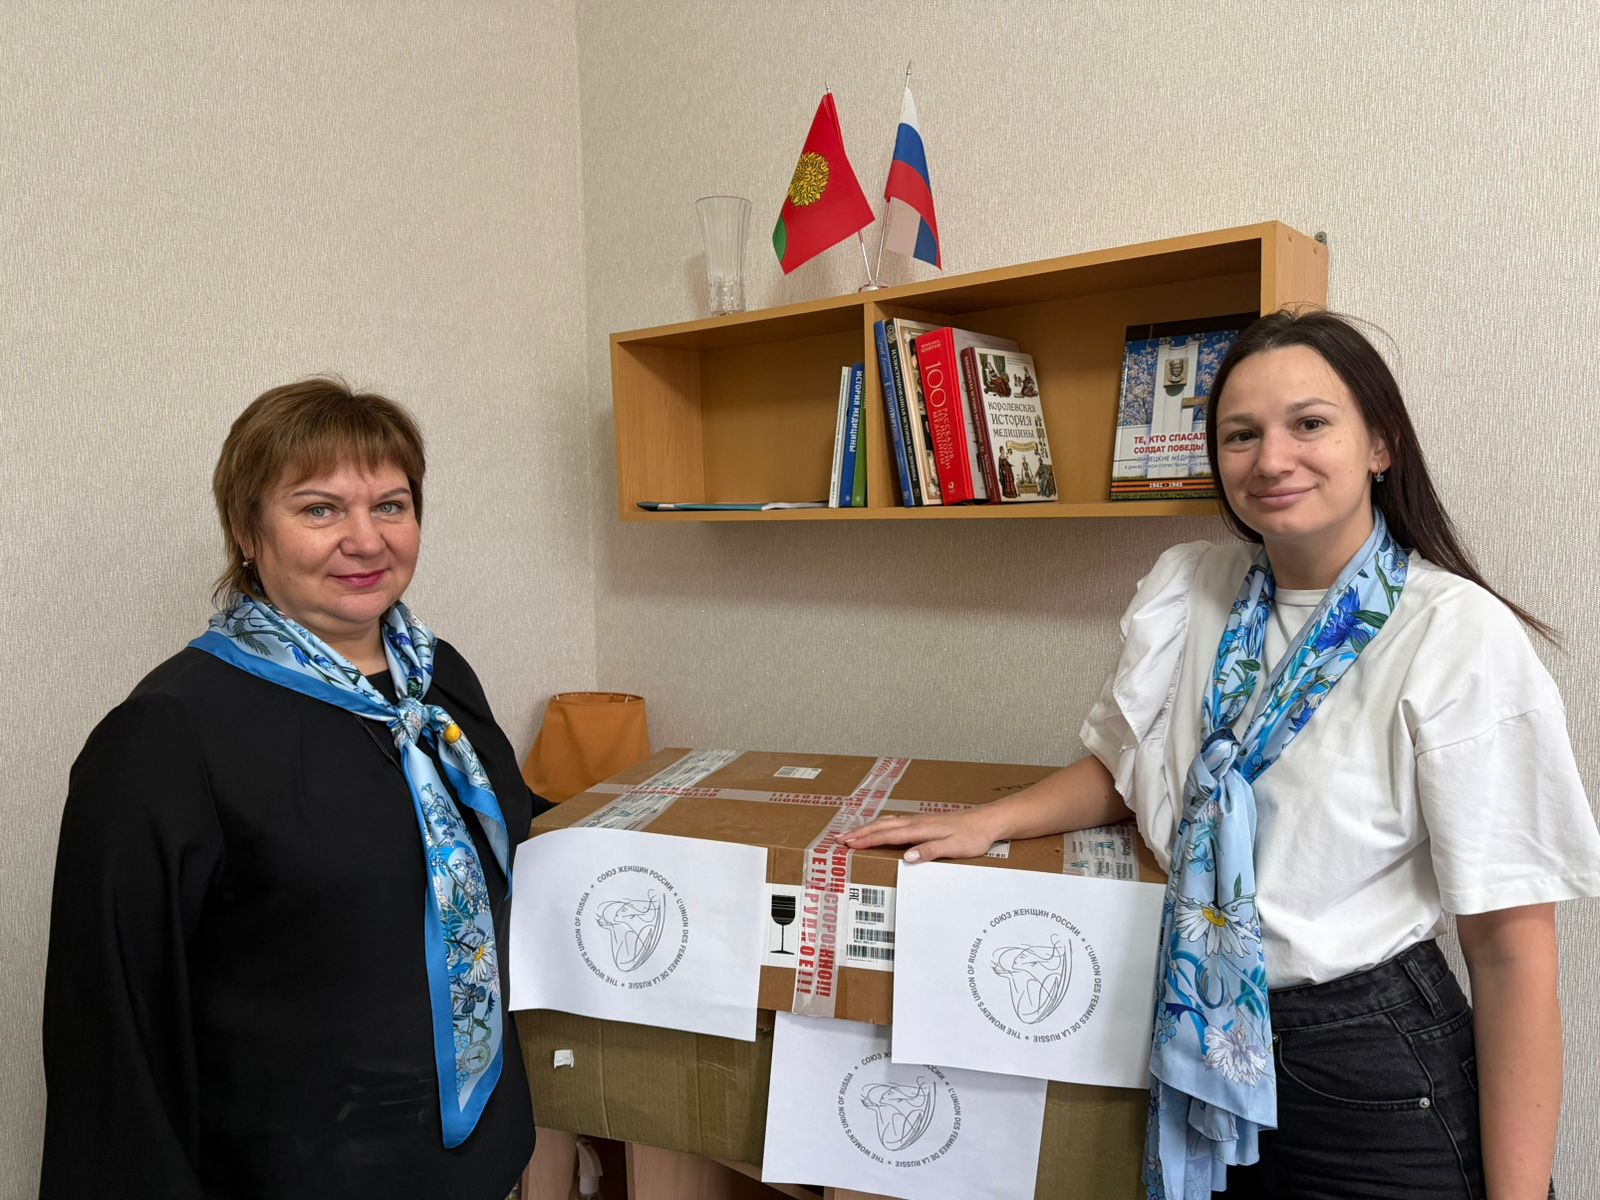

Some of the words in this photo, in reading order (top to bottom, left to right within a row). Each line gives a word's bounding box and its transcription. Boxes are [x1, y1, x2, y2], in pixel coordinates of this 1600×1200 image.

[853, 370, 863, 405] ИСТОРИЯ
[925, 361, 947, 407] 100
[987, 401, 1036, 413] КОРОЛЕВСКАЯ
[937, 409, 944, 421] ИЗ
[990, 413, 1033, 427] ИСТОРИЯ
[849, 407, 860, 453] МЕДИЦИНЫ
[943, 408, 954, 459] РАССКАЗОВ
[993, 428, 1035, 439] МЕДИЦИНЫ
[933, 411, 945, 465] МЕДИЦИНЫ
[1134, 436, 1146, 445] ТЕ,
[1148, 434, 1167, 444] КТО
[940, 424, 951, 469] ИСТОРИИ
[1133, 445, 1166, 454] СОЛДАТ
[1167, 443, 1204, 453] ПОБЕДЫ
[597, 868, 617, 883] СОЮЗ
[618, 865, 649, 875] ЖЕНЩИН
[649, 869, 675, 892] РОССИИ
[849, 888, 860, 902] EAC
[575, 892, 590, 916] RUSSIA
[676, 898, 689, 927] L'UNION
[574, 917, 581, 927] OF
[989, 911, 1012, 928] СОЮЗ
[1012, 908, 1049, 918] ЖЕНЩИН
[1050, 913, 1080, 937] РОССИИ
[575, 928, 585, 952] UNION
[681, 929, 689, 944] DES
[968, 937, 983, 964] RUSSIA
[581, 950, 606, 980] WOMEN'S
[669, 944, 687, 973] FEMMES
[1085, 944, 1101, 976] L'UNION
[659, 970, 669, 981] DE
[967, 964, 975, 975] OF
[605, 976, 618, 987] THE
[628, 979, 653, 989] RUSSIE
[652, 975, 661, 985] LA
[1093, 978, 1101, 994] DES
[967, 976, 981, 1002] UNION
[1079, 994, 1100, 1025] FEMMES
[977, 1001, 1006, 1034] WOMEN'S
[1006, 1027, 1021, 1040] THE
[1061, 1028, 1072, 1038] LA
[1070, 1022, 1081, 1033] DE
[1033, 1033, 1061, 1043] RUSSIE
[861, 1052, 883, 1066] СОЮЗ
[838, 1072, 854, 1095] RUSSIA
[837, 1095, 845, 1105] OF
[947, 1087, 961, 1116] L'UNION
[838, 1106, 849, 1129] UNION
[952, 1117, 961, 1131] DES
[845, 1129, 871, 1157] WOMEN'S
[939, 1131, 959, 1156] FEMMES
[870, 1153, 884, 1164] THE
[895, 1160, 921, 1168] RUSSIE
[921, 1156, 930, 1165] LA
[929, 1152, 940, 1161] DE
